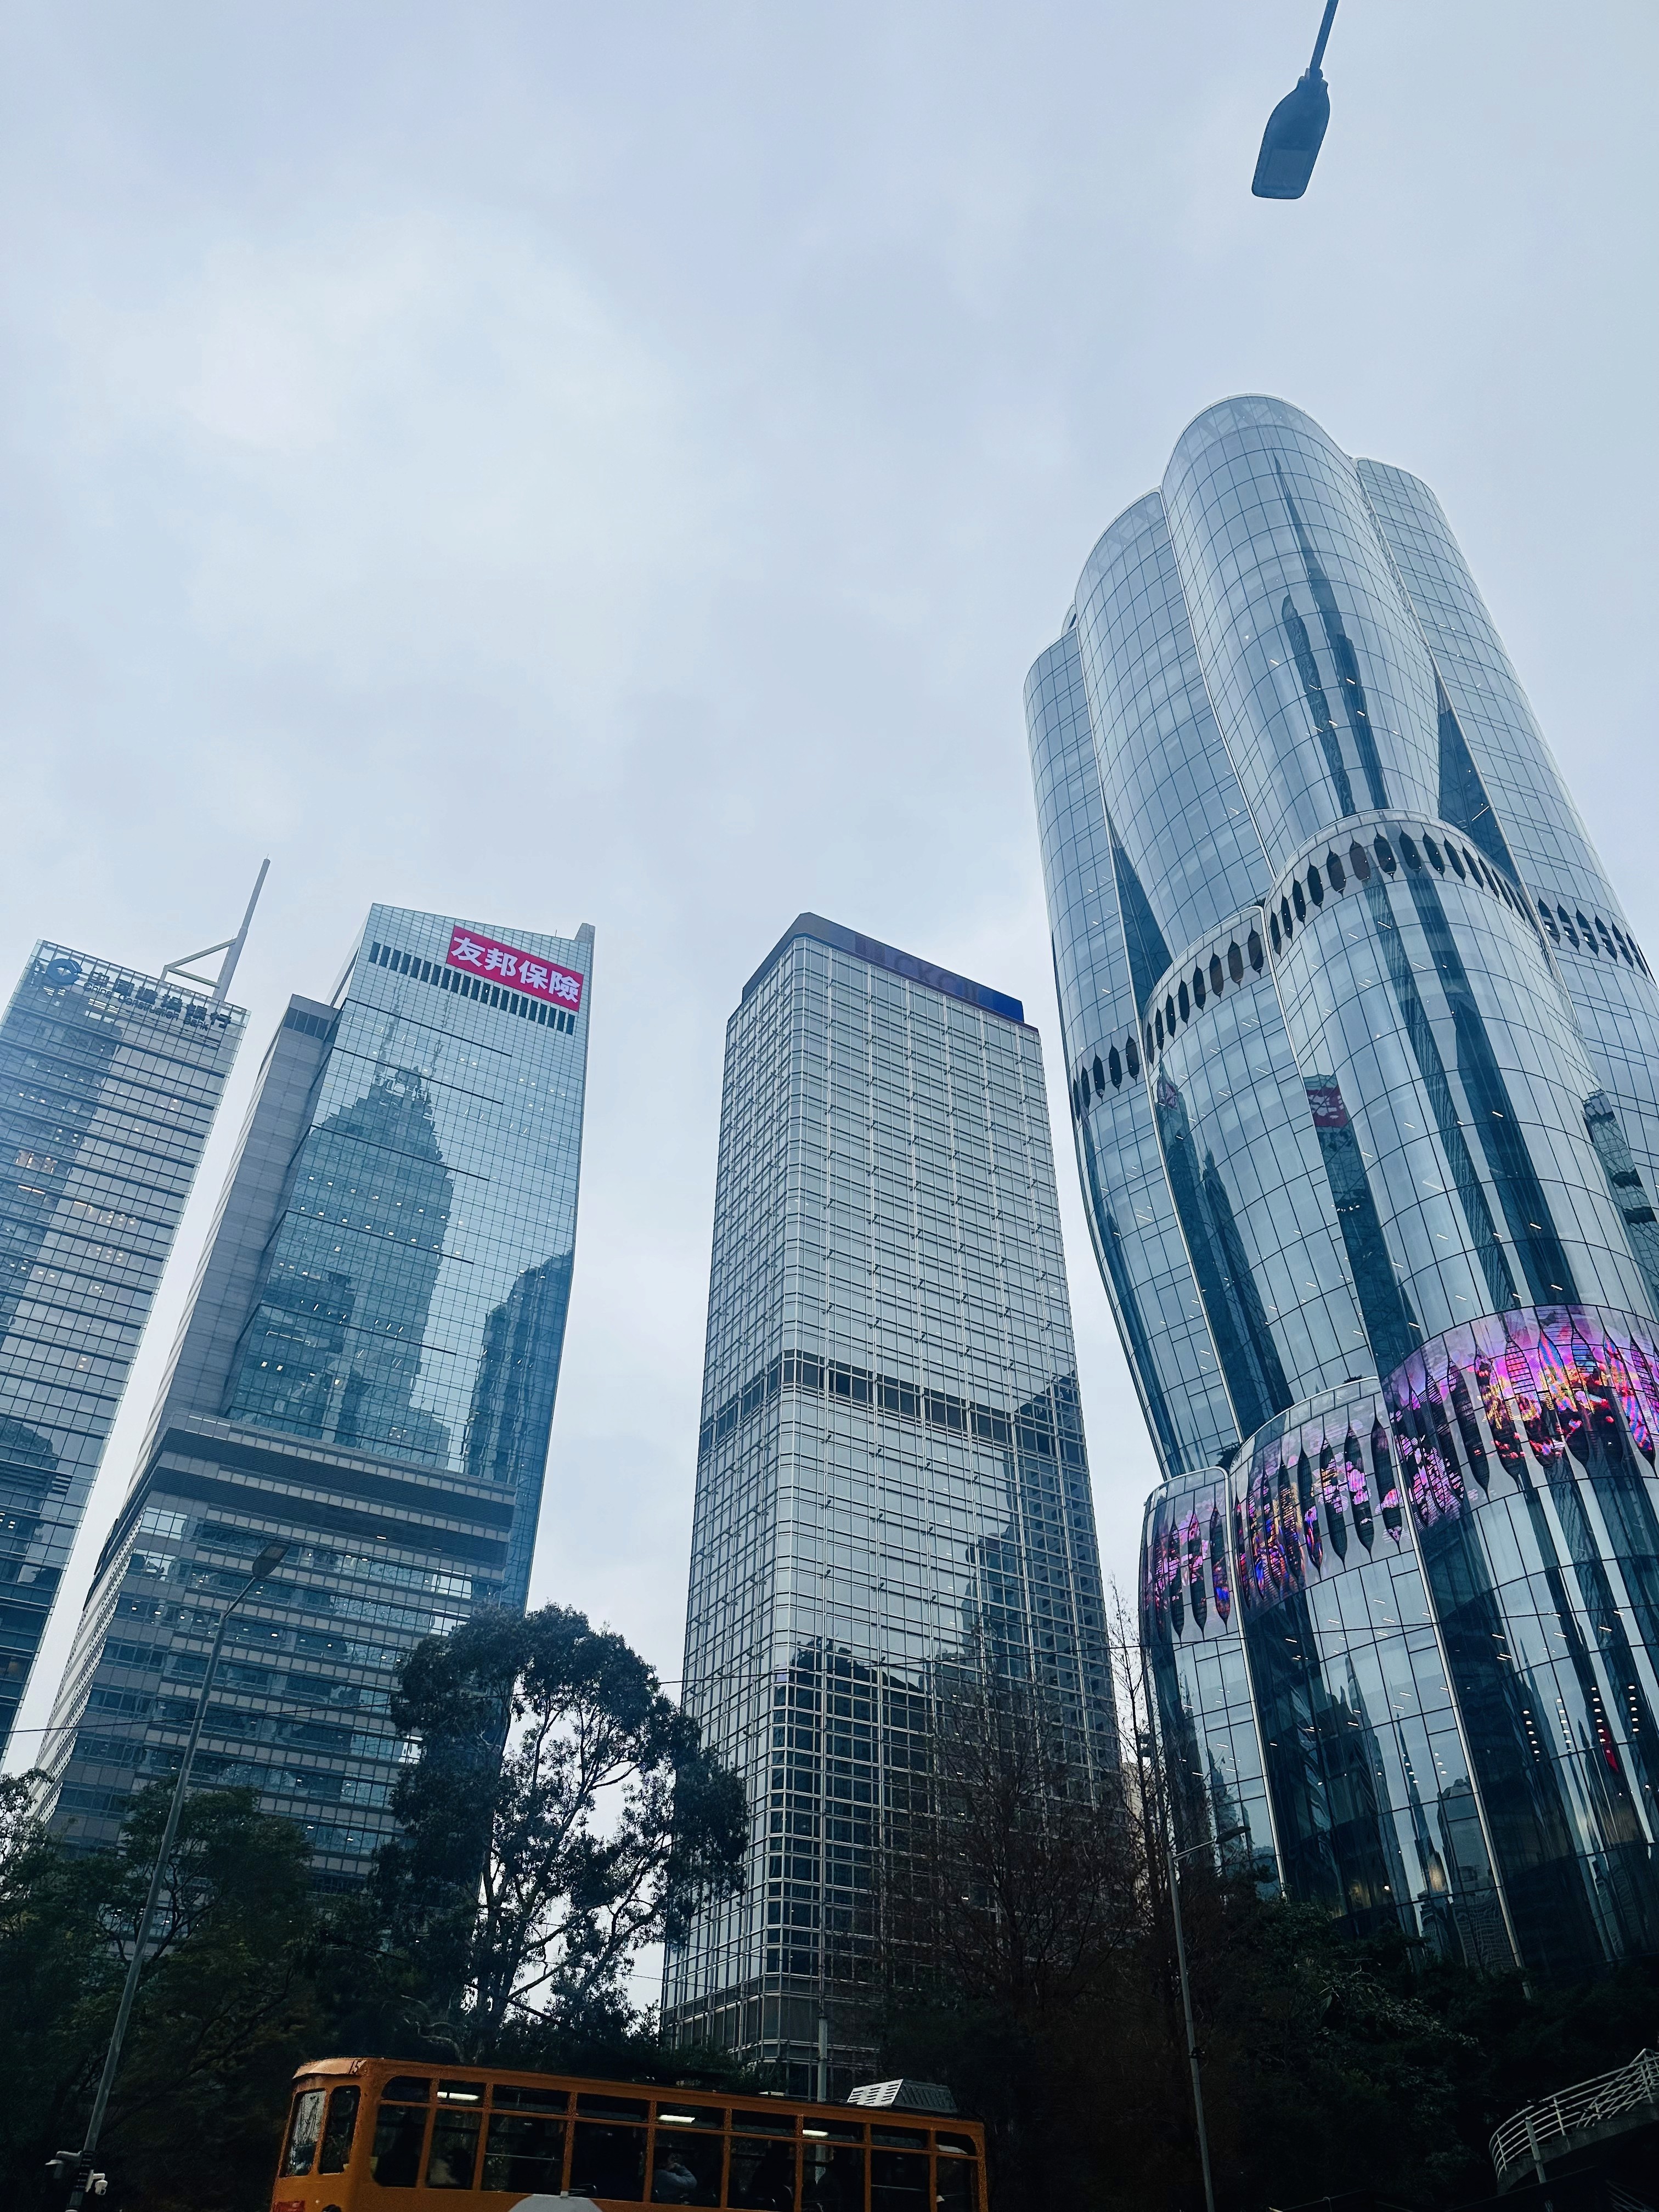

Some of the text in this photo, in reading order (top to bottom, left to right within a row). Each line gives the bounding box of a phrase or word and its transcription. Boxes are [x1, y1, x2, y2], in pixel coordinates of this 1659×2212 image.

[451, 936, 581, 1003] 友邦保險
[84, 981, 209, 1031] China Construction Bank
